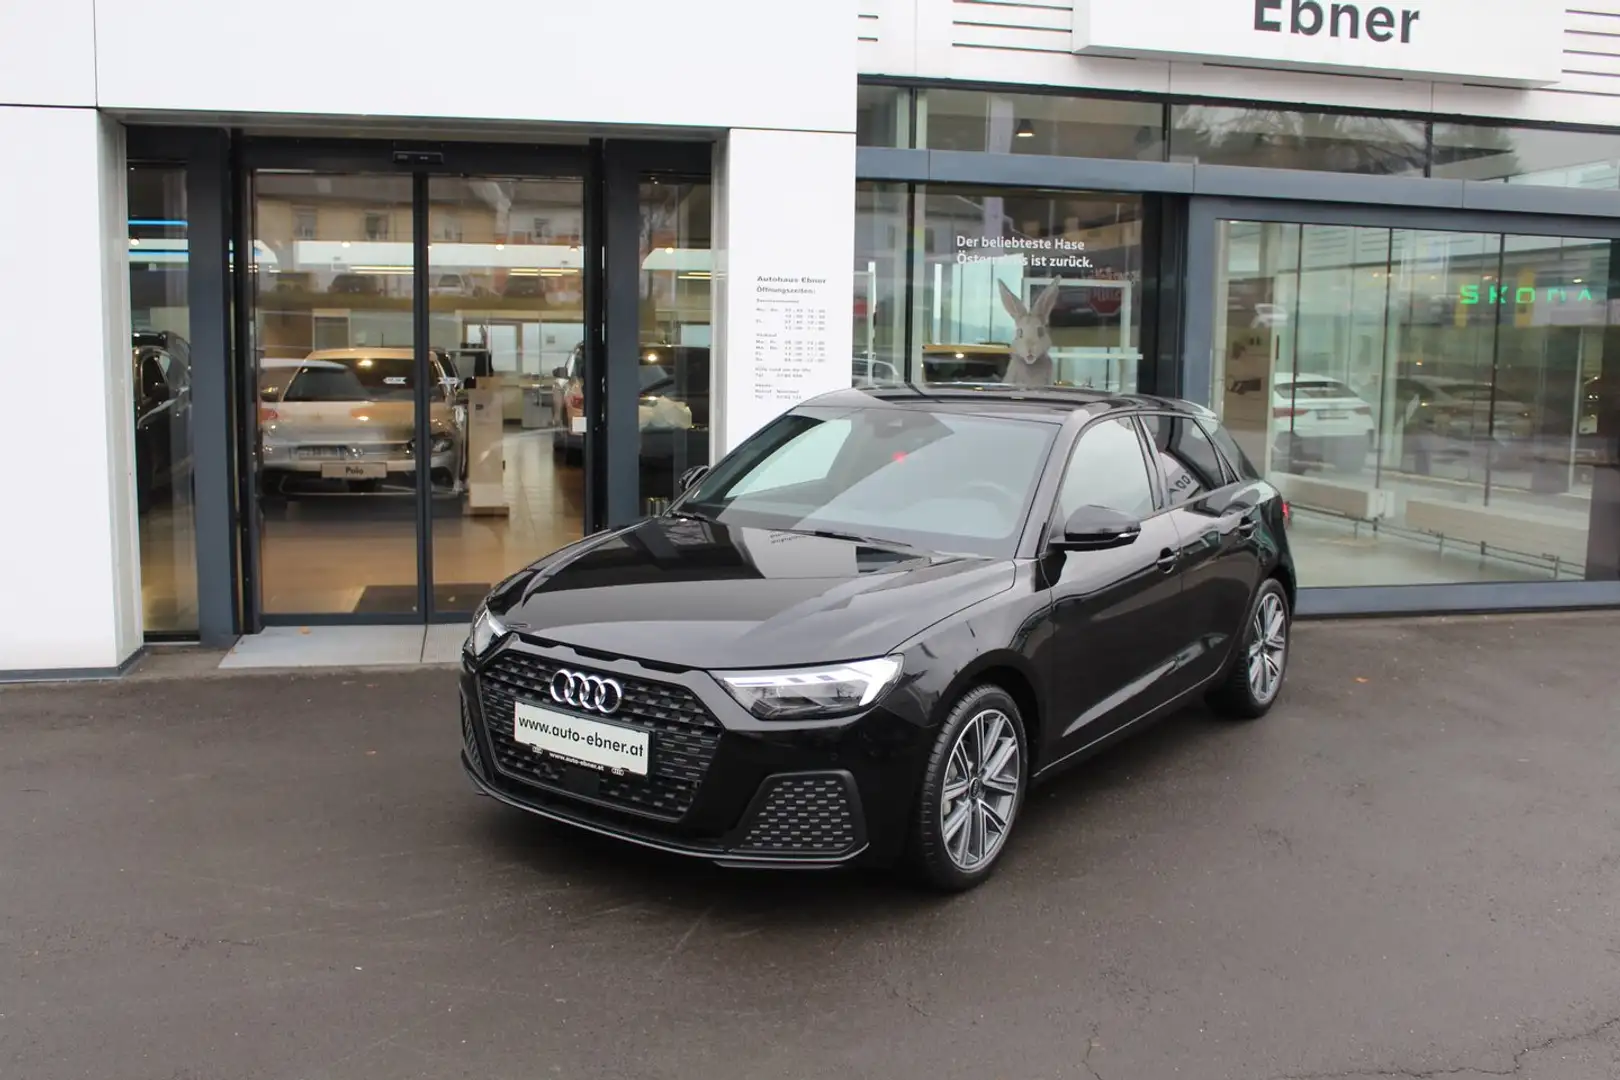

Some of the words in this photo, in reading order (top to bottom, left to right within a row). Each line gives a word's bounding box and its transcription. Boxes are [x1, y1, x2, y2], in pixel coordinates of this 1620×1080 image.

[1254, 0, 1420, 43] Ebner
[956, 235, 978, 247] Der
[981, 236, 1052, 250] beliebteste
[1054, 238, 1085, 251] Hase
[1031, 254, 1047, 267] ist
[1049, 255, 1093, 268] zurück.
[756, 275, 799, 283] Autohaus
[518, 716, 644, 758] www.auto-ebner.at
